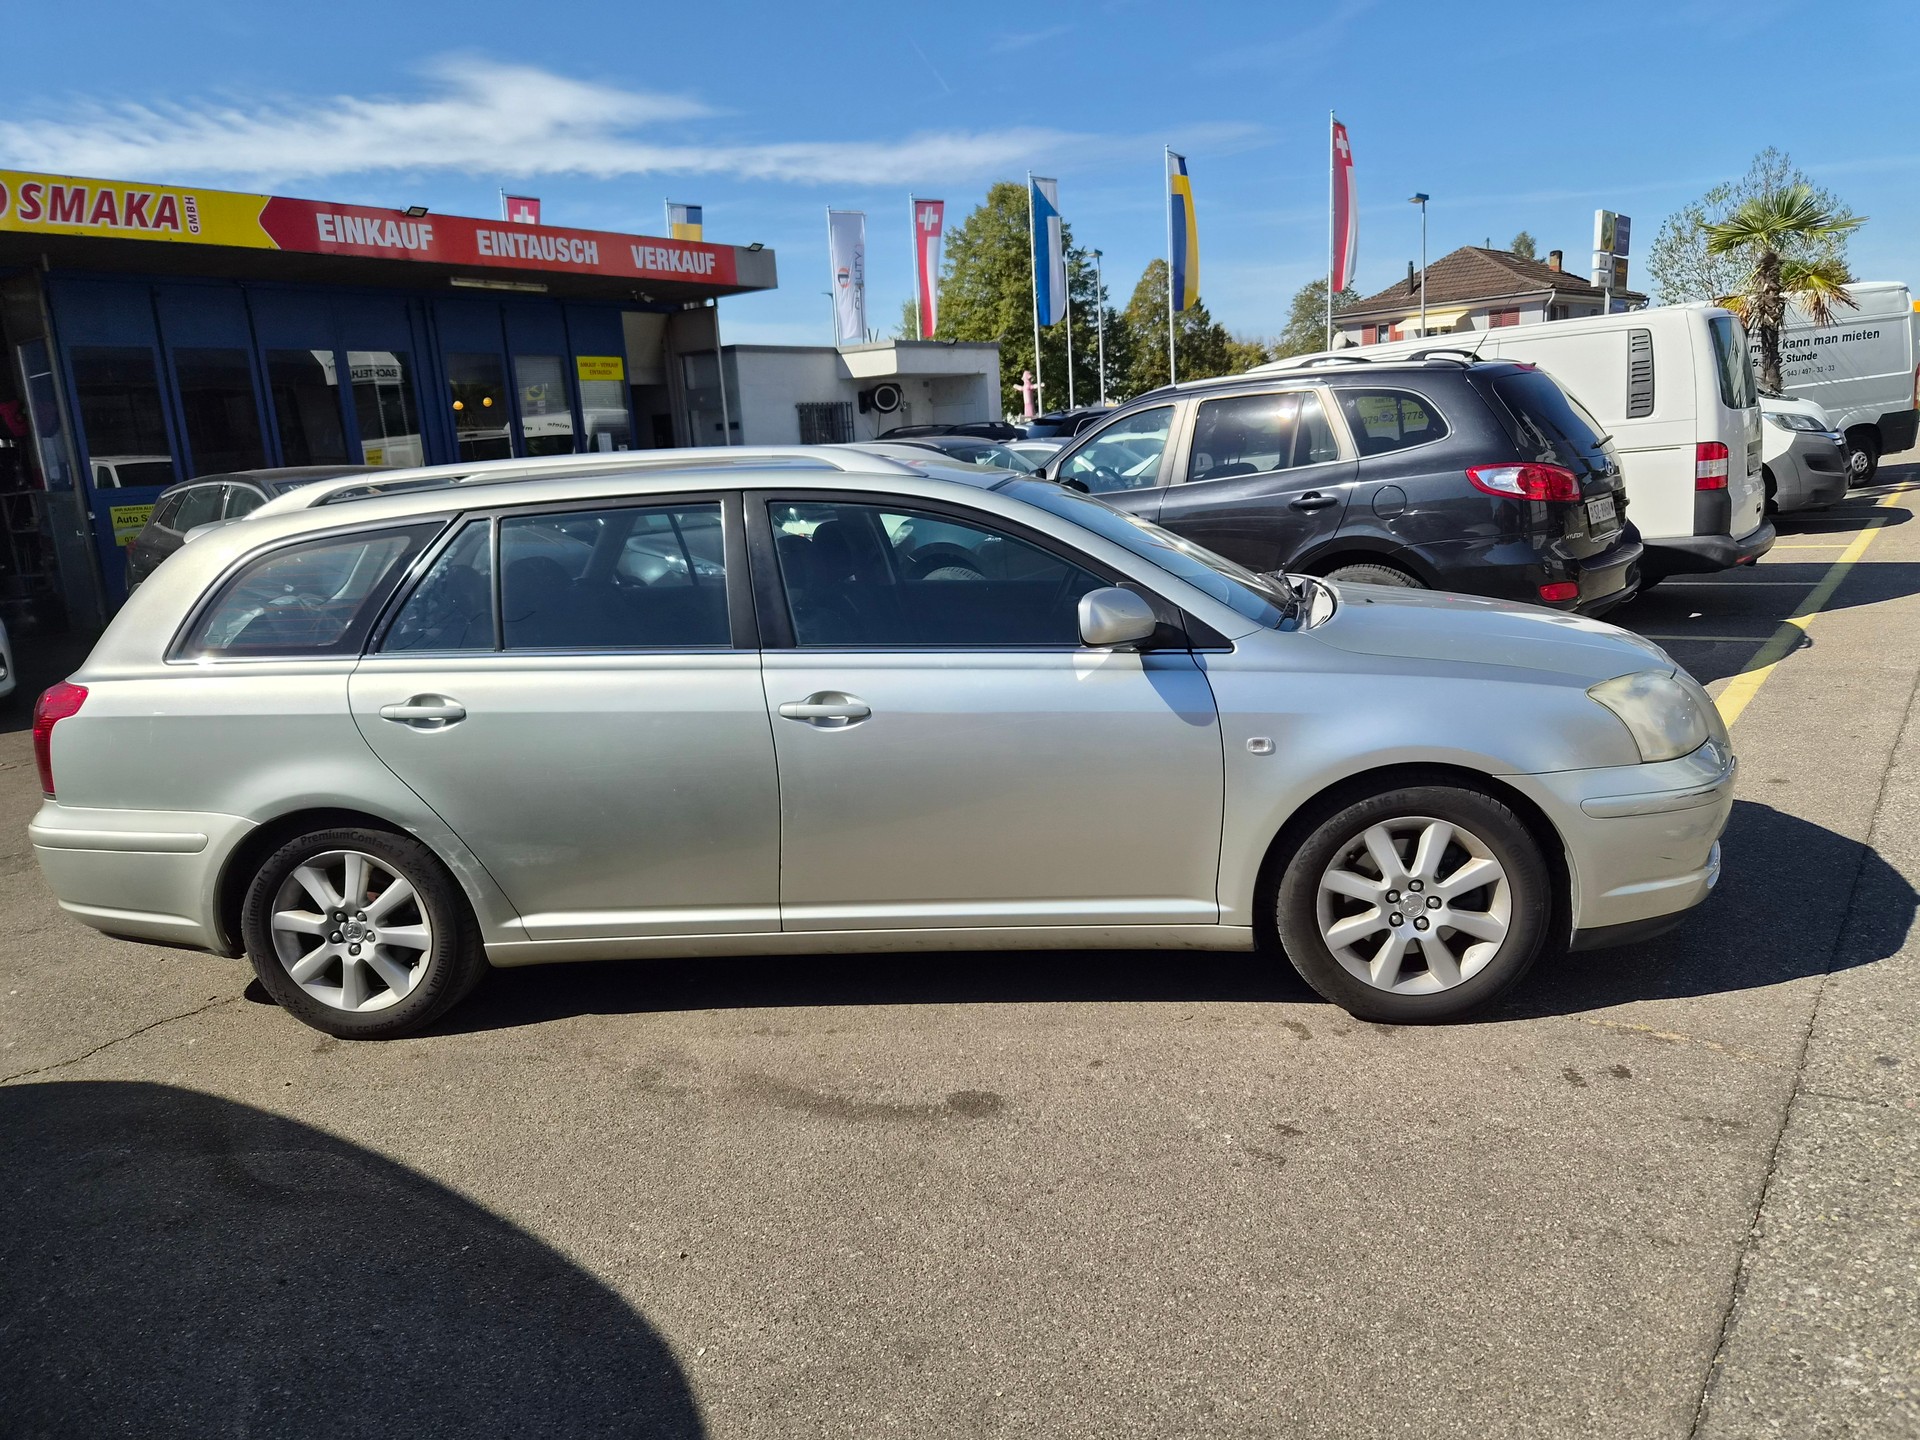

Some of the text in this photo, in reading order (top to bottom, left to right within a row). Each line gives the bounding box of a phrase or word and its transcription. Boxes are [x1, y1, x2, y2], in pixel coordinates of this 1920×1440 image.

[19, 182, 181, 231] SMAKA
[184, 196, 200, 234] GMBH
[316, 213, 434, 250] EINKAUF
[476, 229, 599, 265] EINTAUSCH
[631, 245, 716, 274] VERKAUF
[1782, 330, 1880, 350] kann man mieten
[1786, 351, 1818, 363] Stunde
[117, 515, 139, 524] Auto
[300, 830, 394, 852] PremiumContact
[430, 918, 449, 989] ontinental
